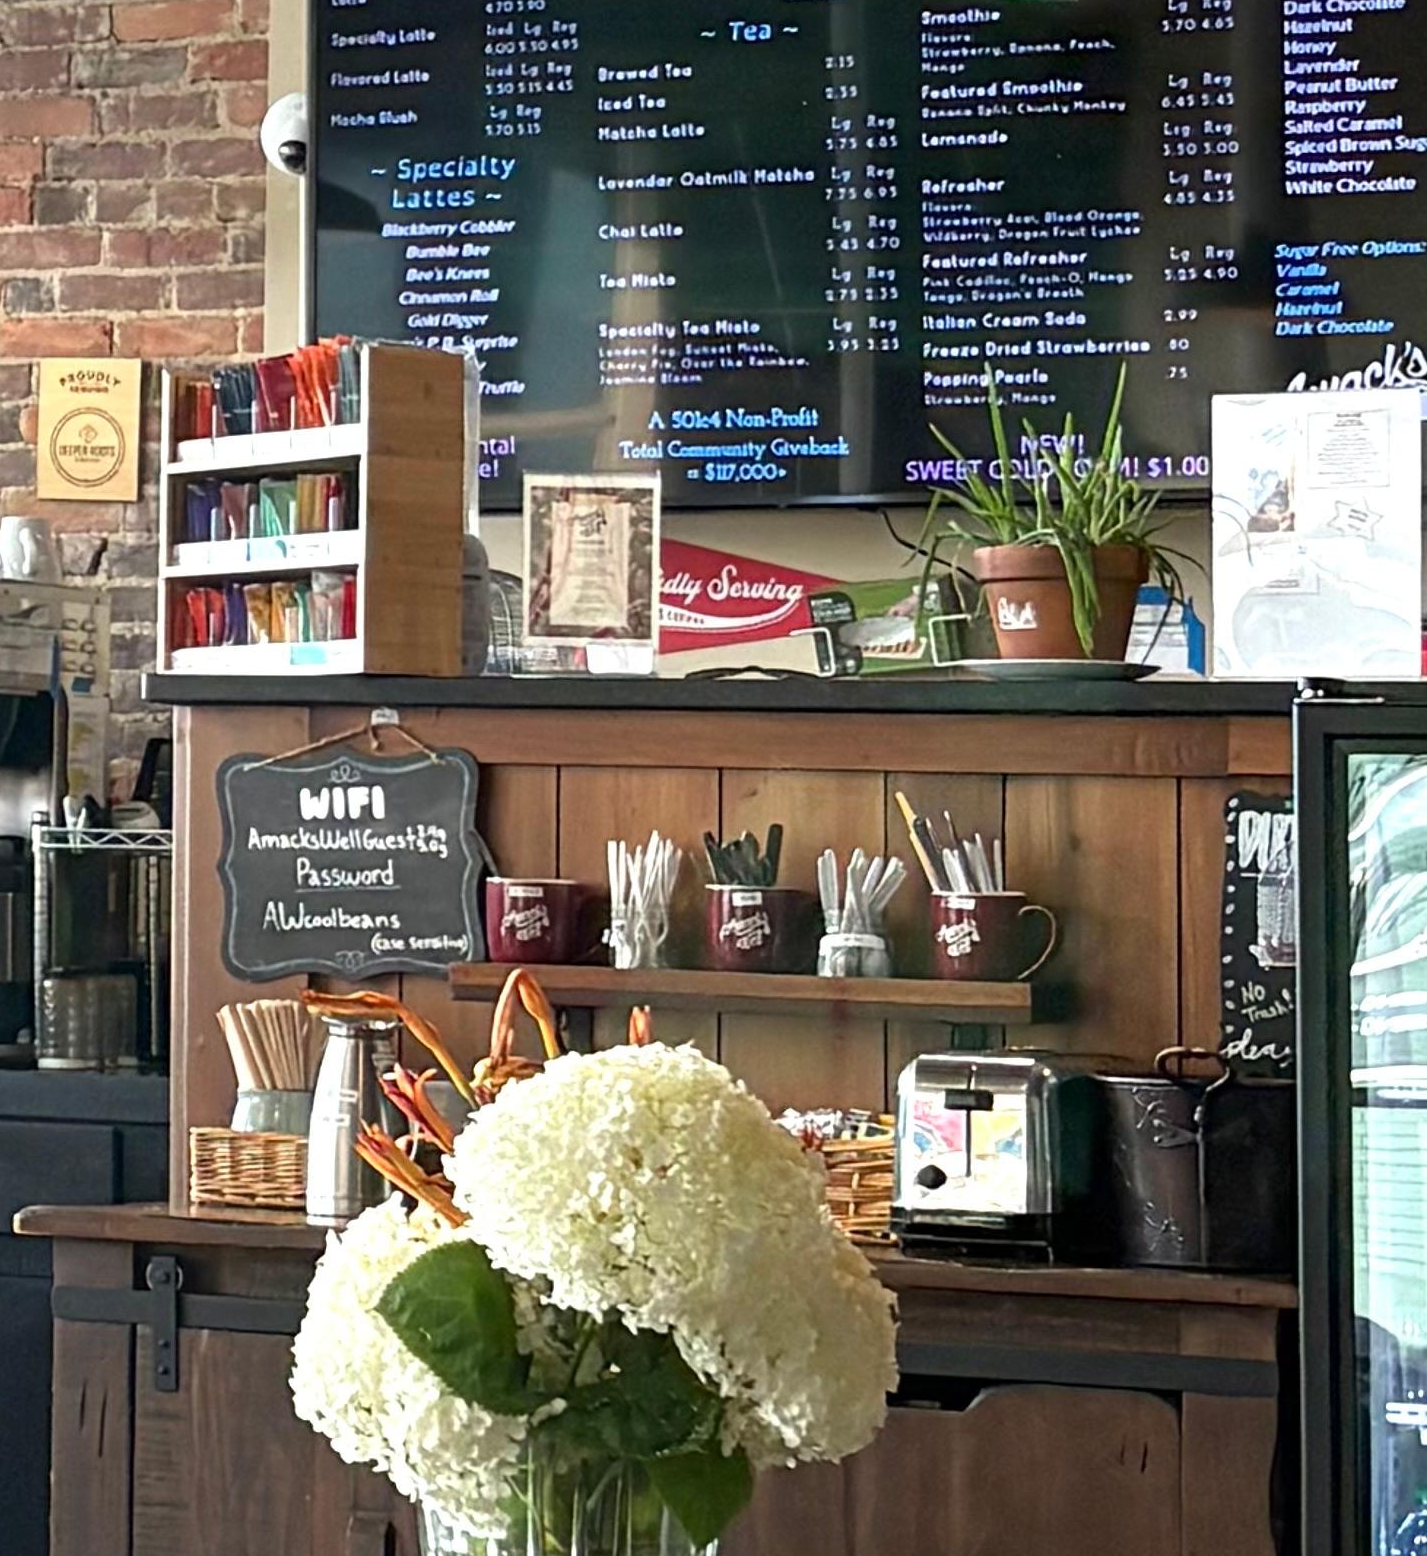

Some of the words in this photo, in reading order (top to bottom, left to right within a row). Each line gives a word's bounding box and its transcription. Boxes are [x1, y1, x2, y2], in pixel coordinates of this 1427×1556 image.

[728, 21, 772, 40] Tea
[665, 63, 692, 78] Tea
[1284, 79, 1341, 94] Peanut
[1345, 77, 1398, 92] Butter
[639, 95, 666, 108] Tea
[1284, 119, 1334, 134] Salted
[1336, 115, 1403, 131] Caramel
[1340, 138, 1392, 152] Brown
[397, 154, 515, 183] Specialty
[392, 188, 475, 209] Lattes
[60, 370, 121, 387] PROUDLY
[648, 411, 665, 430] A
[726, 406, 819, 428] Non-Profit
[618, 440, 663, 459] Total
[667, 440, 766, 460] Community
[770, 436, 850, 456] Giveback
[1148, 456, 1209, 477] $1.00
[300, 786, 385, 820] WIFI
[296, 858, 394, 887] Password
[263, 901, 401, 931] AWcoolbeans
[1242, 982, 1265, 1004] NO
